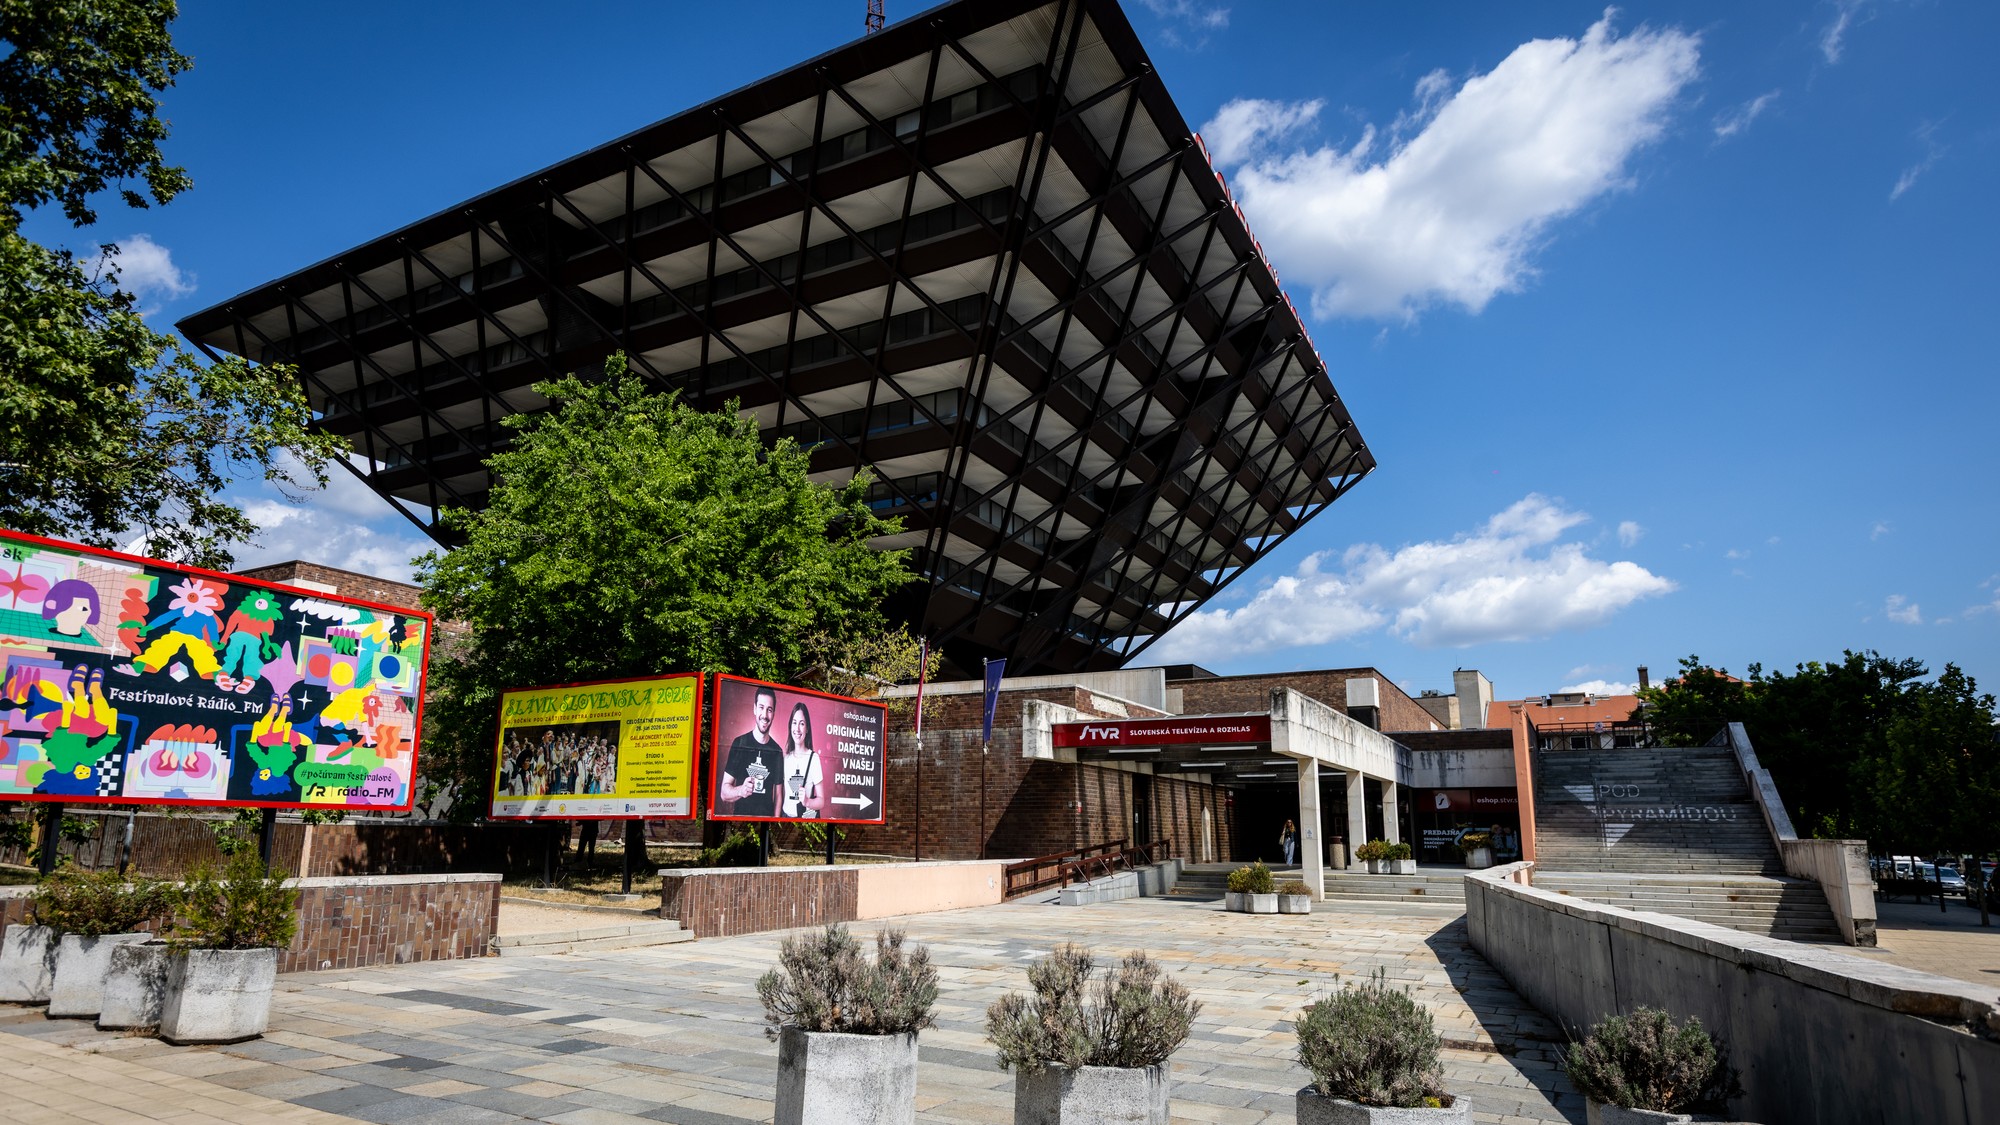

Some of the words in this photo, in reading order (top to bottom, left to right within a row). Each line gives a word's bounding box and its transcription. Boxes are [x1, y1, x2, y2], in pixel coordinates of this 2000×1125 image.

[109, 687, 194, 708] Festivalové
[197, 694, 264, 715] Rádio_FM
[506, 695, 557, 716] SLÁVIK
[559, 688, 653, 713] SLOVENSKA
[656, 685, 691, 705] 2026
[590, 711, 622, 719] DVORSKÉHO
[843, 711, 877, 724] eshop.stvr.sk
[826, 723, 876, 742] ORIGINÁLNE
[1079, 725, 1120, 741] STVR
[1130, 726, 1171, 736] SLOVENSKÁ
[1172, 726, 1208, 735] TELEVÍZIA
[1216, 725, 1251, 733] ROZHLAS
[838, 741, 875, 756] DARČEKY
[842, 758, 848, 768] V
[849, 758, 875, 771] NAŠEJ
[301, 769, 346, 781] #počúvam
[834, 773, 874, 786] PREDAJNI
[337, 785, 395, 798] rádio_FM
[1599, 783, 1640, 799] POD
[1602, 804, 1737, 823] PYRAMÍDOU
[1423, 828, 1460, 836] PREDAJŇA
